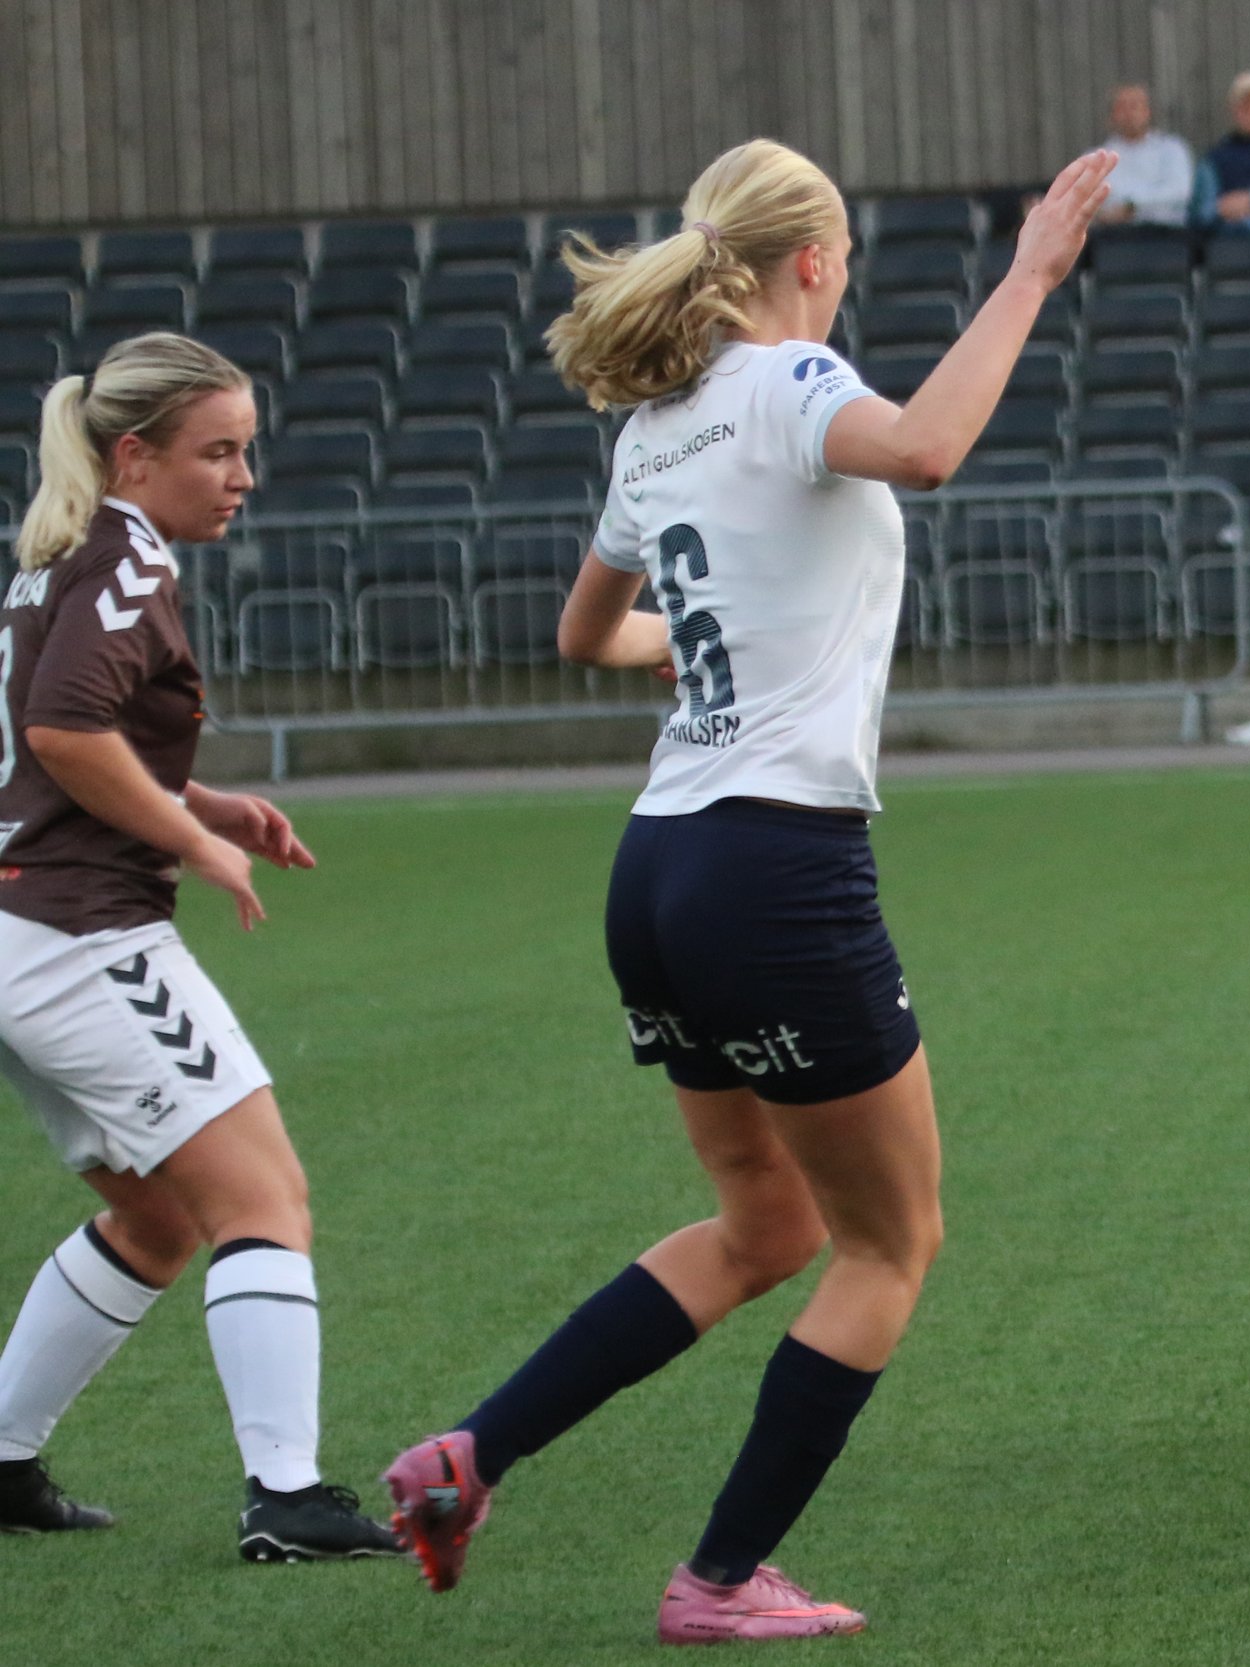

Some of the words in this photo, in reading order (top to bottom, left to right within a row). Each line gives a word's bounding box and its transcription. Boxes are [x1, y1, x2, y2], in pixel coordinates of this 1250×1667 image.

[622, 459, 651, 487] ALTI
[653, 421, 736, 473] GULSKOGEN
[658, 522, 736, 719] 6
